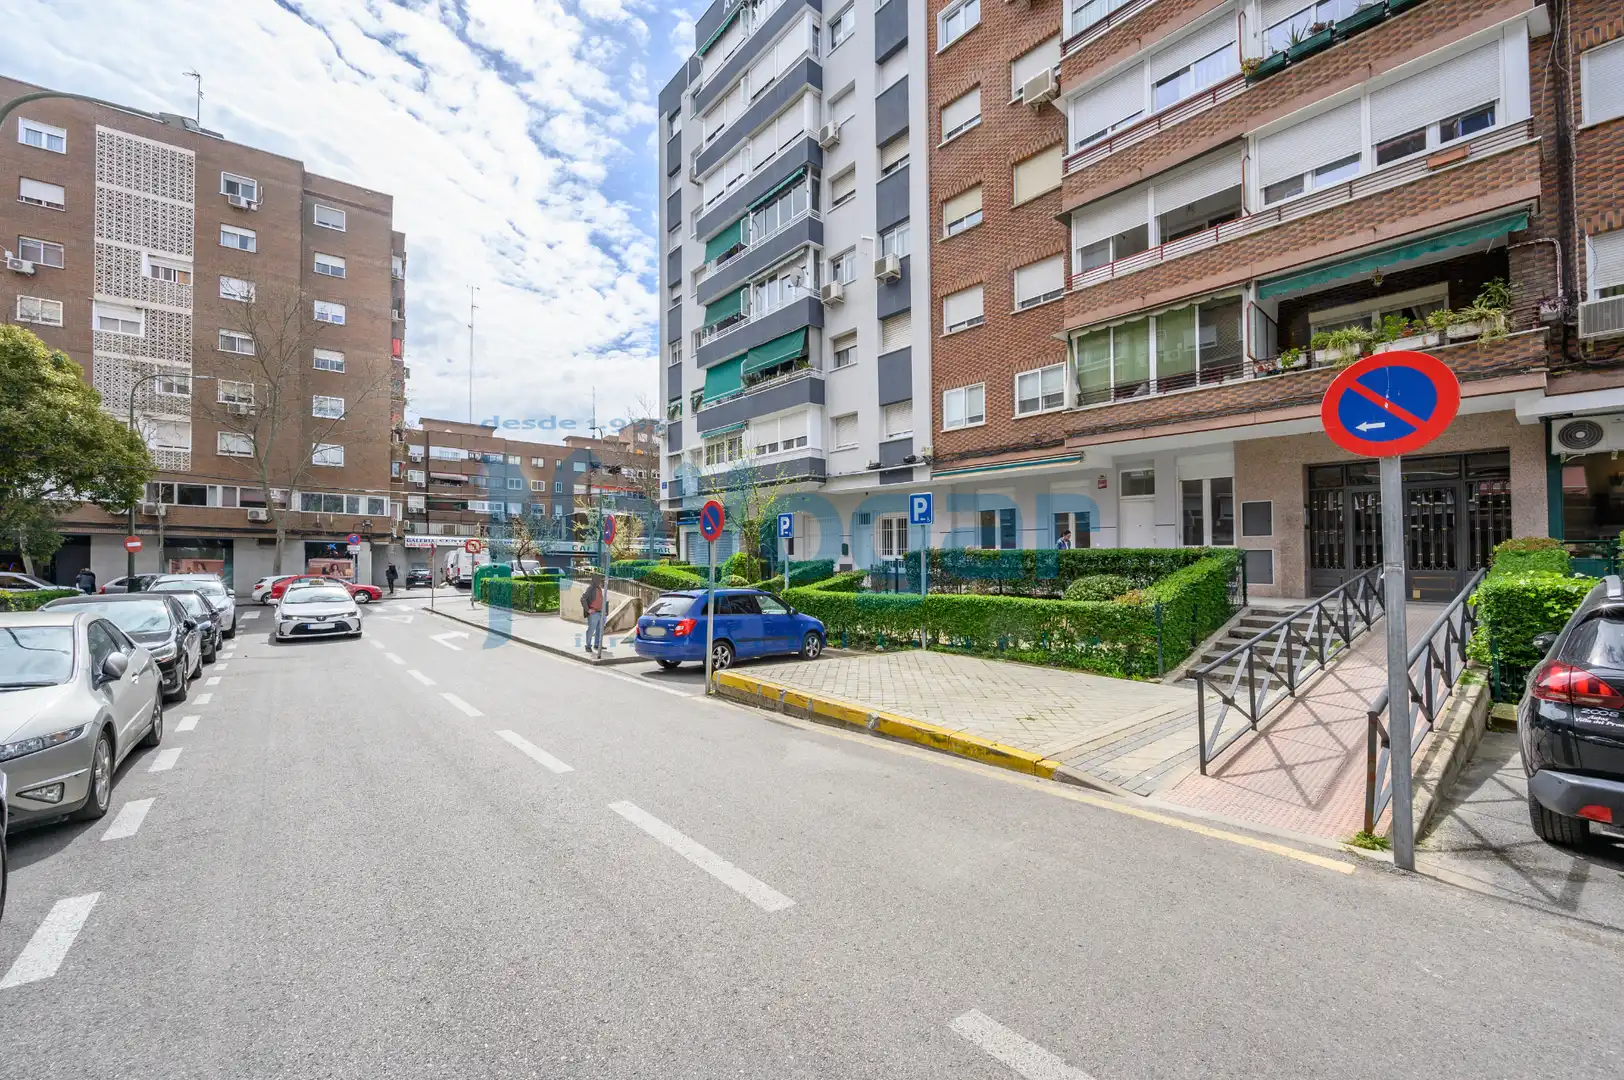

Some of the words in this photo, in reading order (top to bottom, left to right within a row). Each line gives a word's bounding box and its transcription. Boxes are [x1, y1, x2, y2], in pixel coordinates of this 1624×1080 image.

[913, 497, 928, 521] P
[780, 516, 790, 535] P
[1580, 707, 1620, 718] 2008
